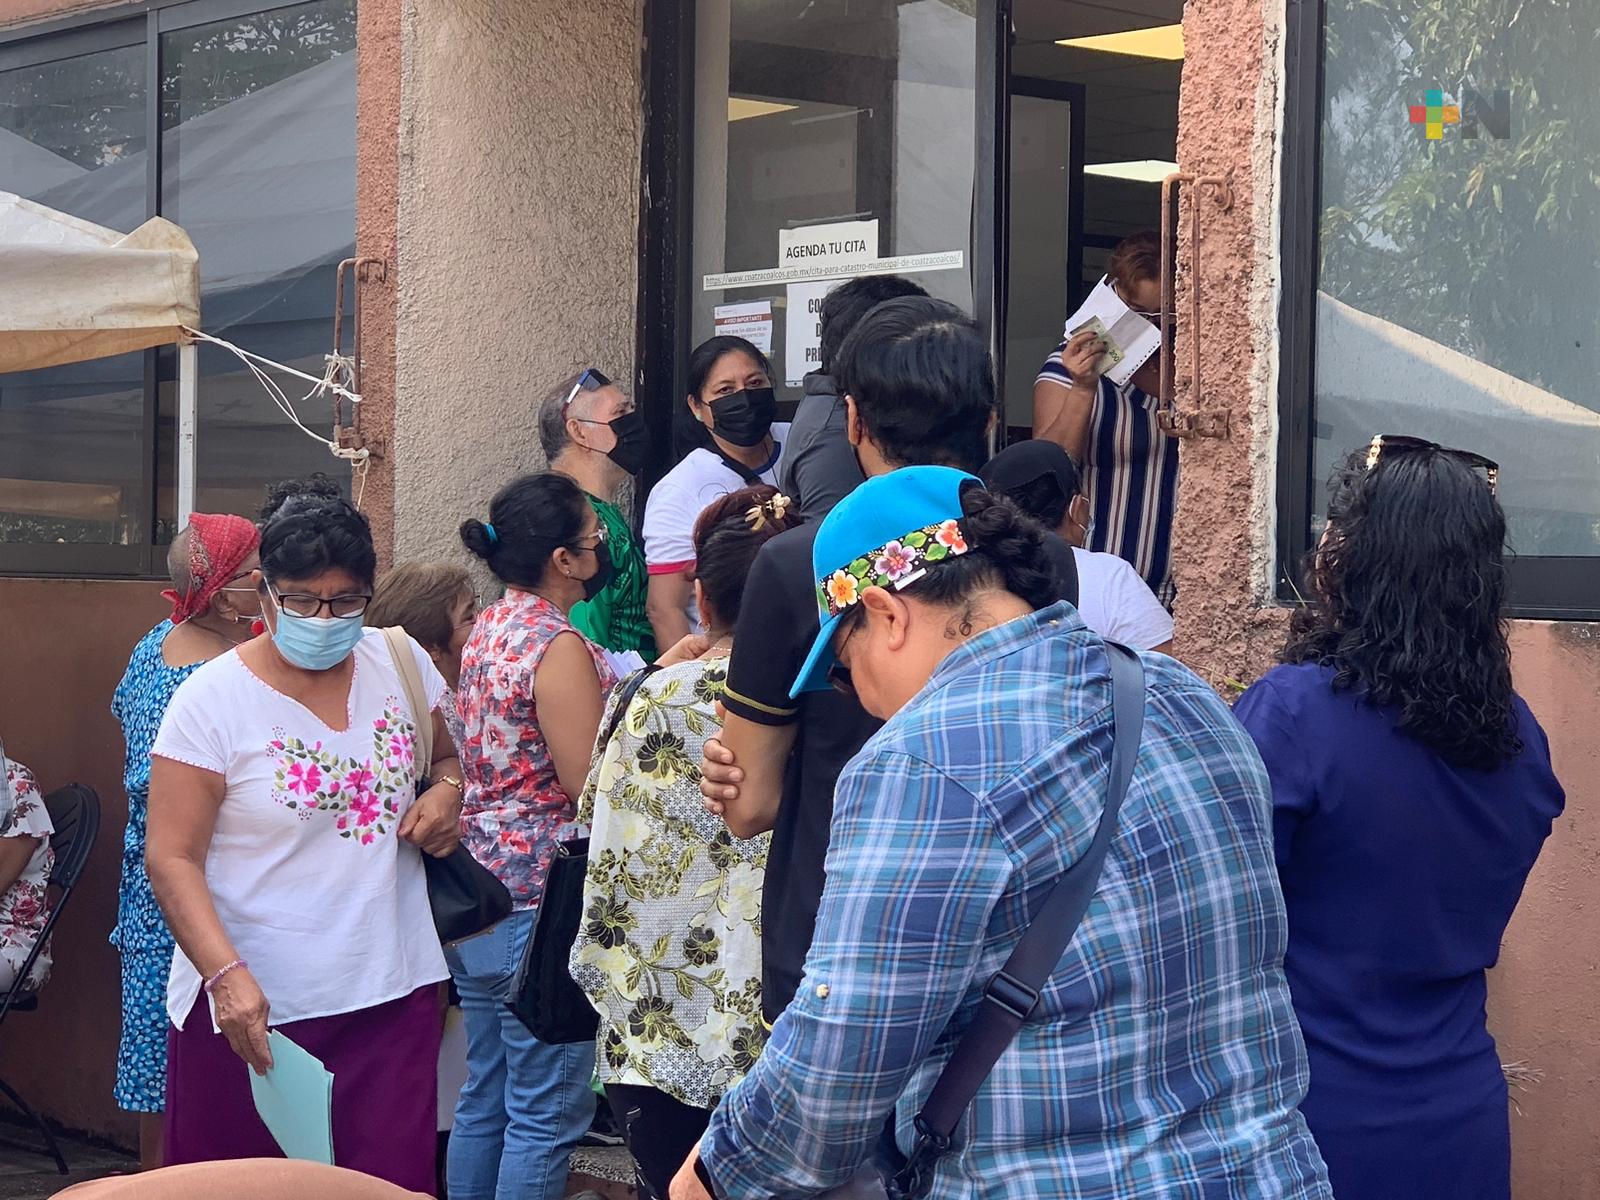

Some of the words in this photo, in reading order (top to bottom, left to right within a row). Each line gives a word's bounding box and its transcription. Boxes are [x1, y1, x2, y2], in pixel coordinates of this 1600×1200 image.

[786, 243, 827, 258] AGENDA
[828, 242, 842, 254] TU
[844, 240, 866, 253] CITA
[808, 298, 820, 314] CO
[737, 315, 763, 323] IMPORTANTE
[806, 347, 822, 362] PRE
